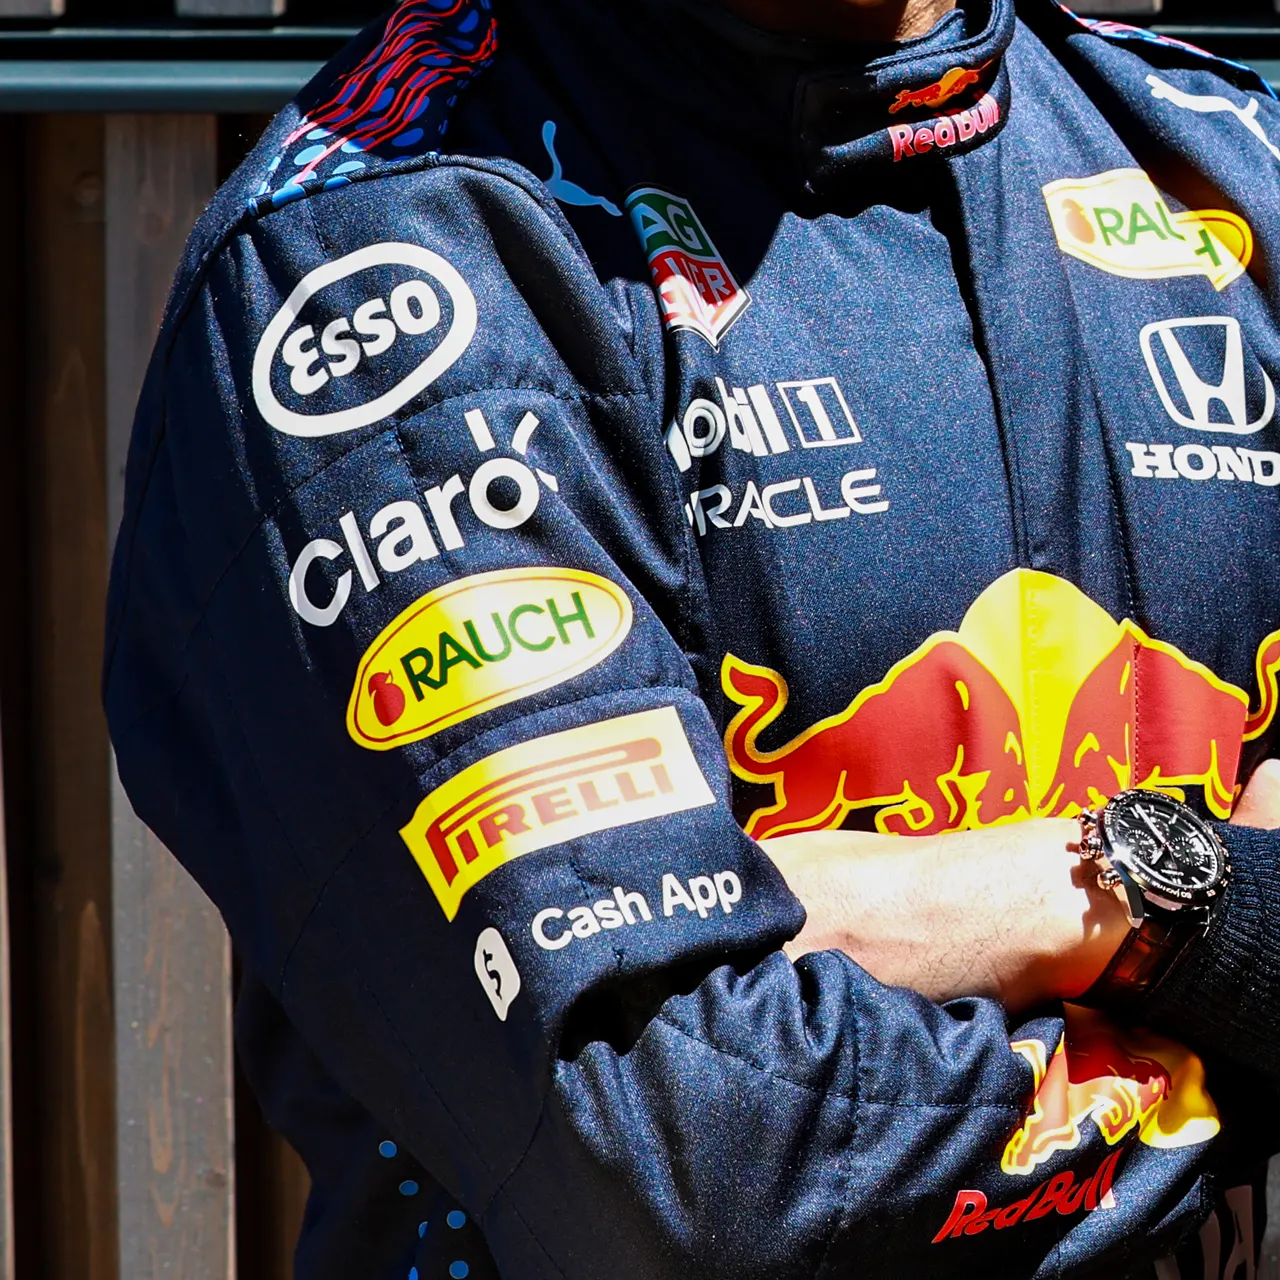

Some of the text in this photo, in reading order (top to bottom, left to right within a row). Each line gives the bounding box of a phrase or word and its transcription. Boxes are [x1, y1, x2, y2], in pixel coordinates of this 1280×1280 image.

[887, 93, 999, 162] Red Bull
[629, 202, 704, 251] AG
[281, 278, 441, 395] Esso
[685, 468, 890, 536] RACLE
[400, 591, 595, 702] RAUCH
[424, 737, 675, 887] PIRELLI
[531, 867, 743, 950] Cash App
[931, 1147, 1116, 1244] Red Bull
